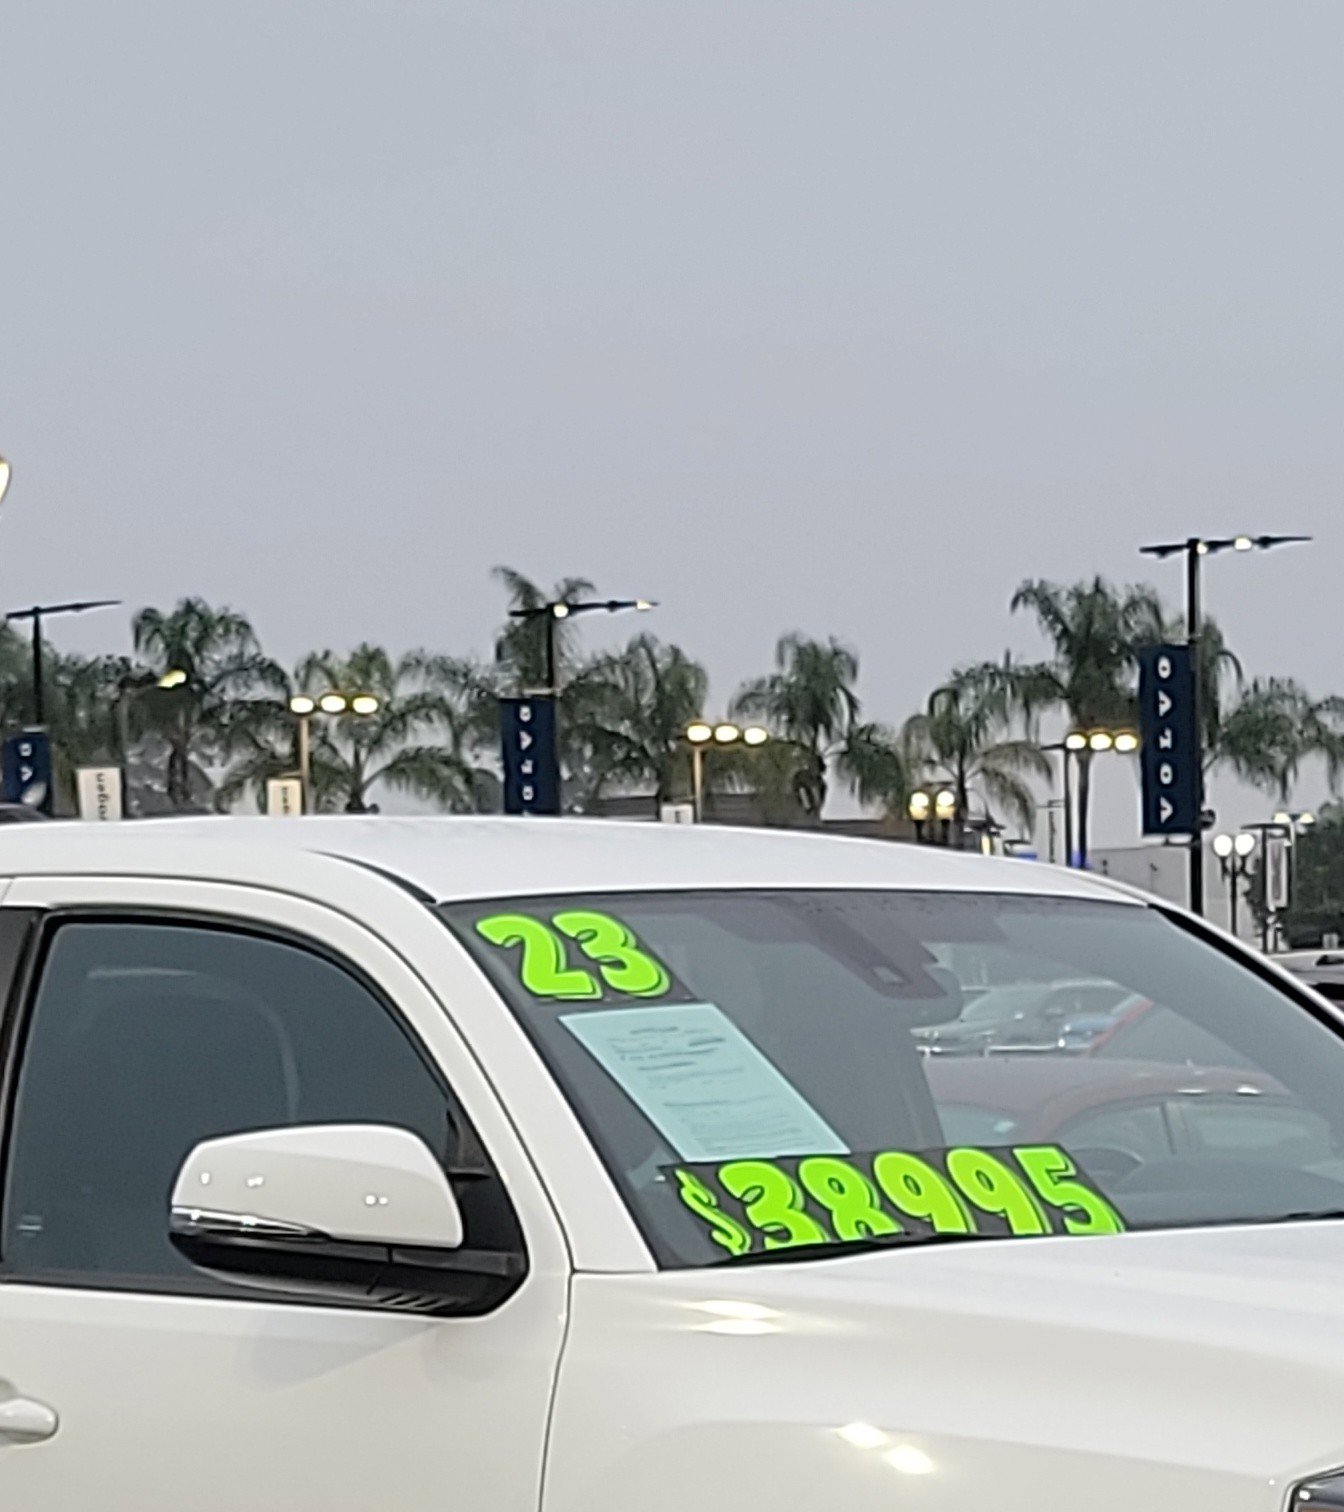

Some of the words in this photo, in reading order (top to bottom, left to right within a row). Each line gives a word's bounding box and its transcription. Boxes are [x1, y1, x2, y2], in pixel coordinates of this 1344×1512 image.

[1157, 655, 1174, 824] VOLVO
[476, 911, 671, 1000] 23
[675, 1146, 1126, 1257] $38995
